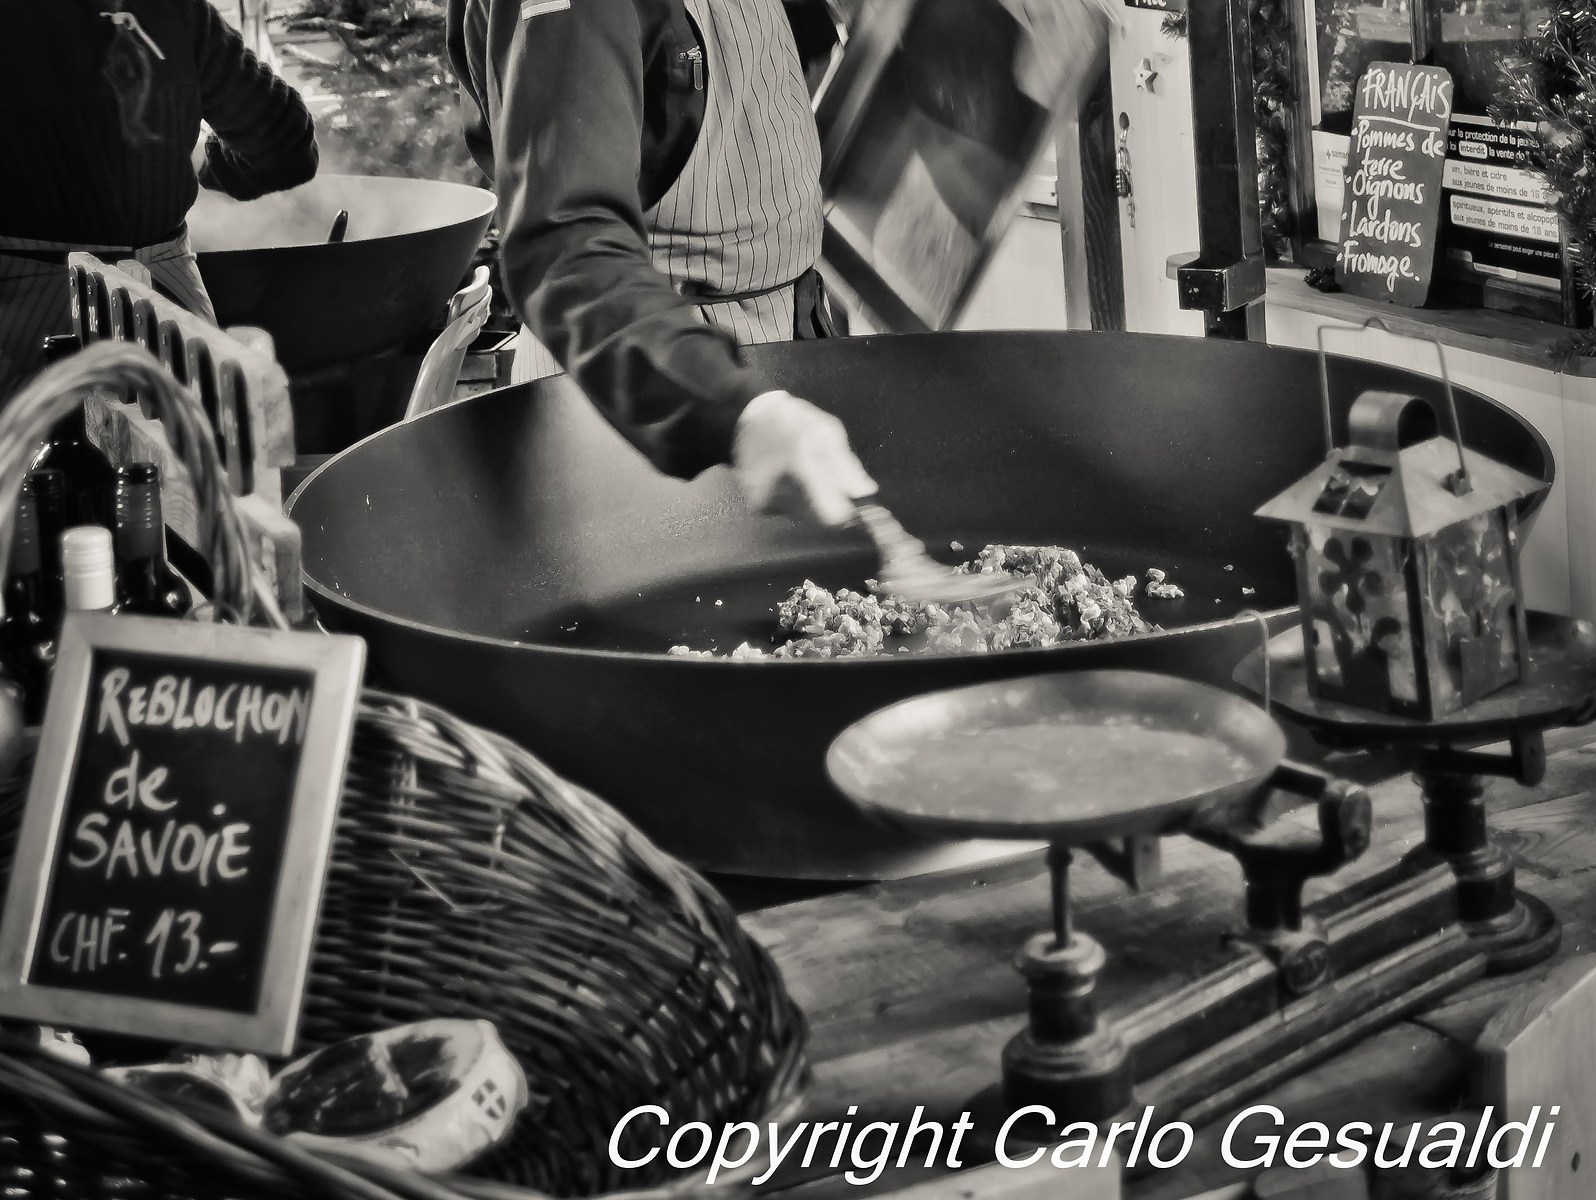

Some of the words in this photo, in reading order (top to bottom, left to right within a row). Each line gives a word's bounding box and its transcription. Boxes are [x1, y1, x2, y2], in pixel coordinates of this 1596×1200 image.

[1356, 120, 1415, 153] Pommes
[1421, 132, 1445, 158] de
[1458, 128, 1464, 138] la
[1465, 131, 1498, 143] protection
[1500, 134, 1509, 144] de
[1510, 134, 1516, 145] la
[1361, 147, 1406, 180] terre
[1460, 143, 1485, 155] interdit
[1489, 147, 1495, 157] la
[1496, 149, 1515, 160] vente
[1463, 166, 1480, 177] bière
[1482, 170, 1488, 178] et
[1490, 171, 1507, 181] cidre
[1352, 169, 1425, 219] Oignons
[1452, 179, 1463, 187] aux
[1464, 179, 1485, 190] jeunes
[1486, 182, 1495, 192] de
[1496, 185, 1517, 195] moins
[1519, 187, 1528, 197] de
[1531, 189, 1540, 199] 16
[1349, 201, 1422, 247] Lardons
[1453, 213, 1464, 222] aux
[1465, 214, 1486, 226] jeunes
[1487, 218, 1496, 228] de
[1497, 221, 1518, 232] moins
[1520, 224, 1530, 233] de
[1532, 226, 1541, 235] 18
[1544, 229, 1558, 238] ans
[1487, 206, 1515, 219] apéritifs
[1517, 212, 1525, 220] et
[104, 748, 179, 811] de
